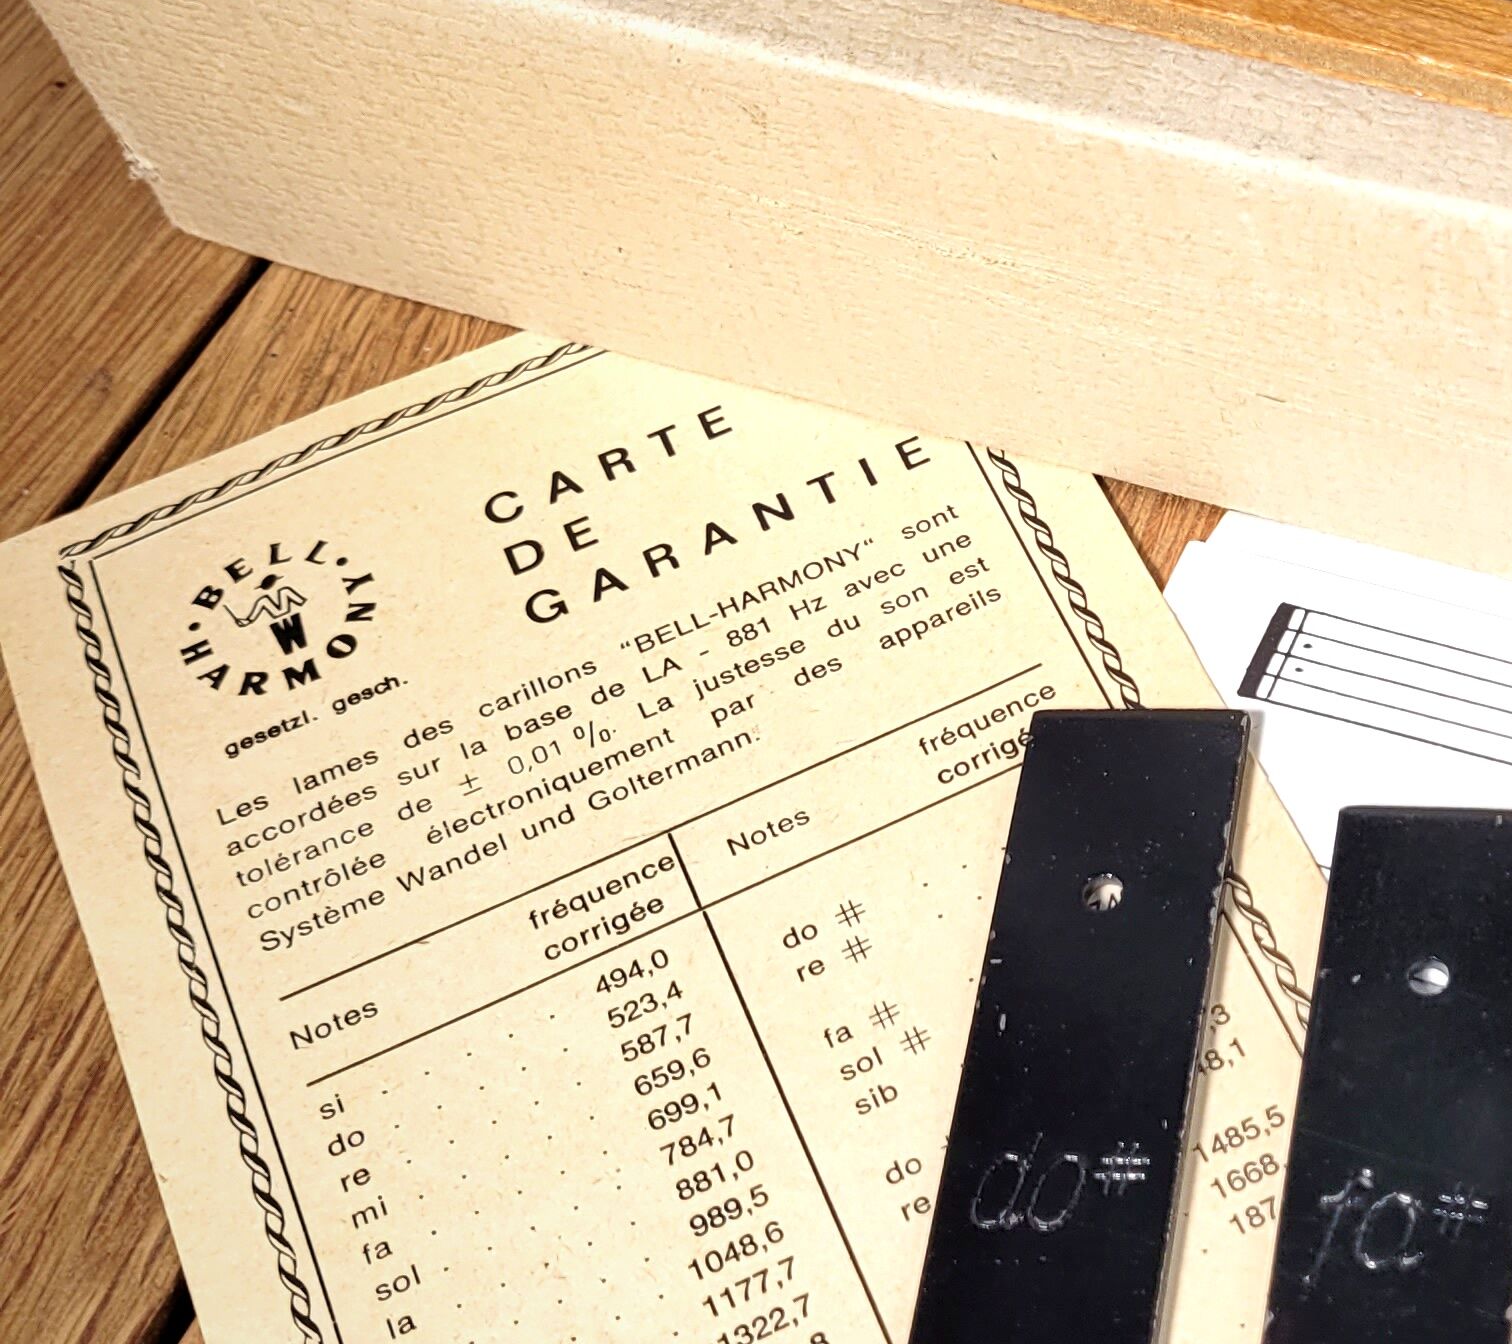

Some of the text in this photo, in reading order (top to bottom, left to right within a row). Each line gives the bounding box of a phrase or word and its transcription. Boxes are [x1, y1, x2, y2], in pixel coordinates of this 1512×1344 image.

[484, 404, 733, 524] CARTE
[502, 515, 600, 577] DE
[524, 435, 932, 624] GARANTIE
[191, 540, 328, 611] BELL
[215, 795, 270, 826] Les
[292, 750, 379, 795] lames
[403, 719, 455, 749] des
[478, 660, 598, 718] carillons
[900, 504, 960, 540] sont
[226, 534, 972, 857] accordées sur la base de LA 881 Hz avec une
[224, 676, 409, 760] gesetzl. gesch.
[235, 557, 991, 887] tolérance de 0,01 La justesse du son est
[247, 588, 1002, 919] contrôlée électroniquement par des appareils
[918, 685, 1057, 756] fréquence
[726, 810, 811, 857] Notes
[259, 889, 386, 952] Système
[395, 832, 508, 893] Wandel
[520, 803, 576, 841] und
[528, 855, 676, 931] fréquence
[544, 897, 665, 961] corrigée
[782, 923, 819, 949] do
[796, 959, 826, 983] re
[288, 1001, 379, 1051] Notes
[319, 948, 669, 1121] si 494,0
[823, 1025, 854, 1049] fa
[327, 979, 684, 1157] do 523,4
[839, 1045, 884, 1081] sol
[340, 1012, 692, 1193] re 587,7
[855, 1084, 898, 1116] sib
[1192, 1104, 1286, 1163] 1485,5
[351, 1047, 711, 1230] mi 659,6
[362, 1081, 722, 1265] fa 699,1
[885, 1157, 922, 1185] do
[375, 1113, 735, 1302] sol 784,7
[689, 1183, 769, 1238] 989,5
[900, 1196, 932, 1222] re
[1210, 1152, 1280, 1199] 1668
[385, 1149, 754, 1340] la 881,0
[687, 1220, 785, 1281] 1048,6
[701, 1255, 795, 1318] 1177,7
